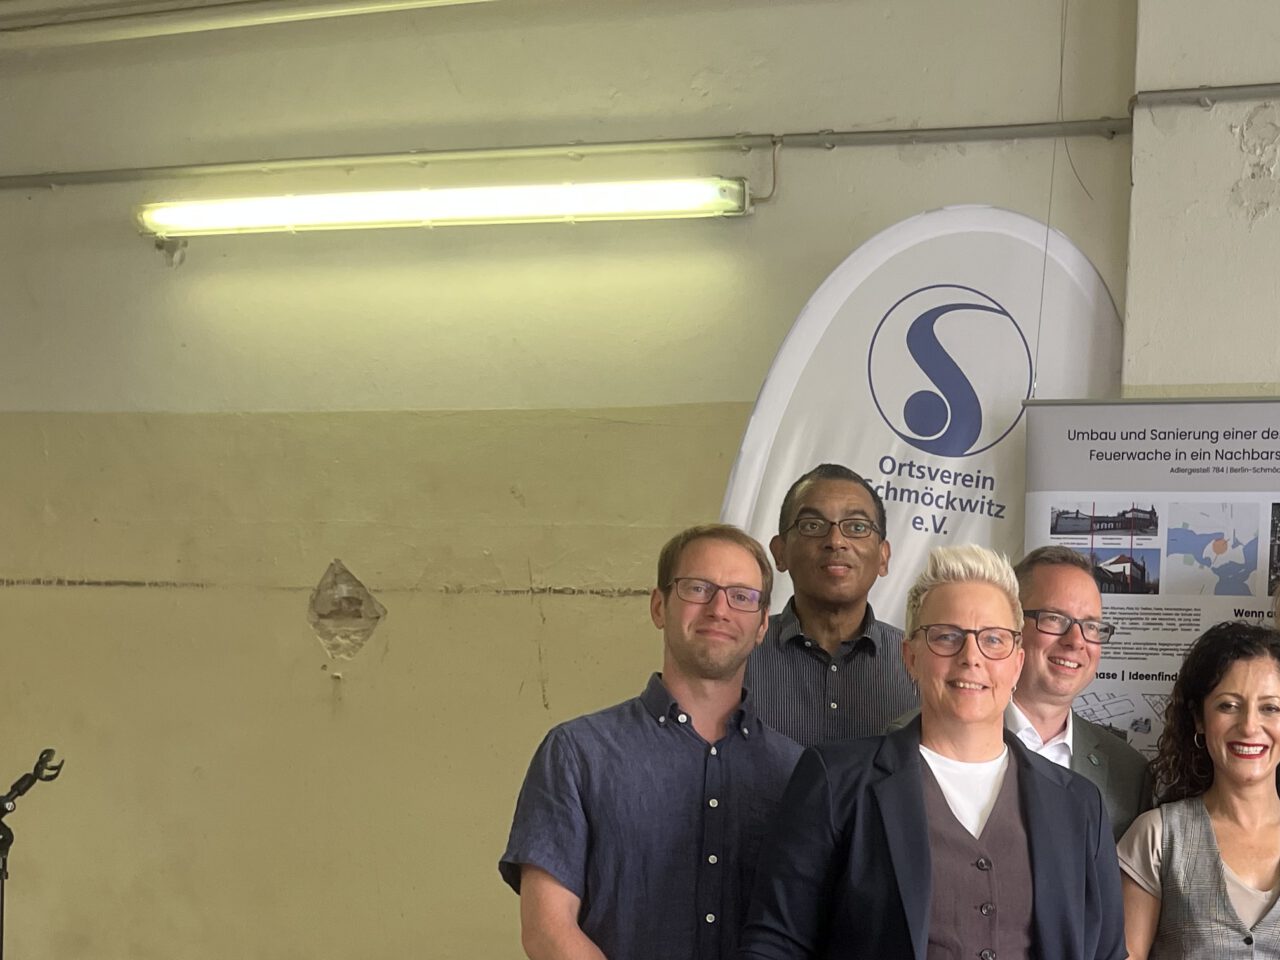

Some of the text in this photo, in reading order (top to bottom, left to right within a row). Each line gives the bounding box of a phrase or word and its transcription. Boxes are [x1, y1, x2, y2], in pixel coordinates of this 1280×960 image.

[1067, 428, 1117, 441] Umbau
[1120, 428, 1147, 441] und
[1150, 427, 1219, 444] Sanierung
[1223, 427, 1258, 440] einer
[1089, 448, 1172, 462] Feuerwache
[1175, 447, 1187, 461] in
[1190, 447, 1211, 461] ein
[878, 455, 995, 491] Ortsverein
[1212, 466, 1225, 474] 784
[911, 514, 949, 535] e.V.
[1233, 608, 1265, 618] Wenn
